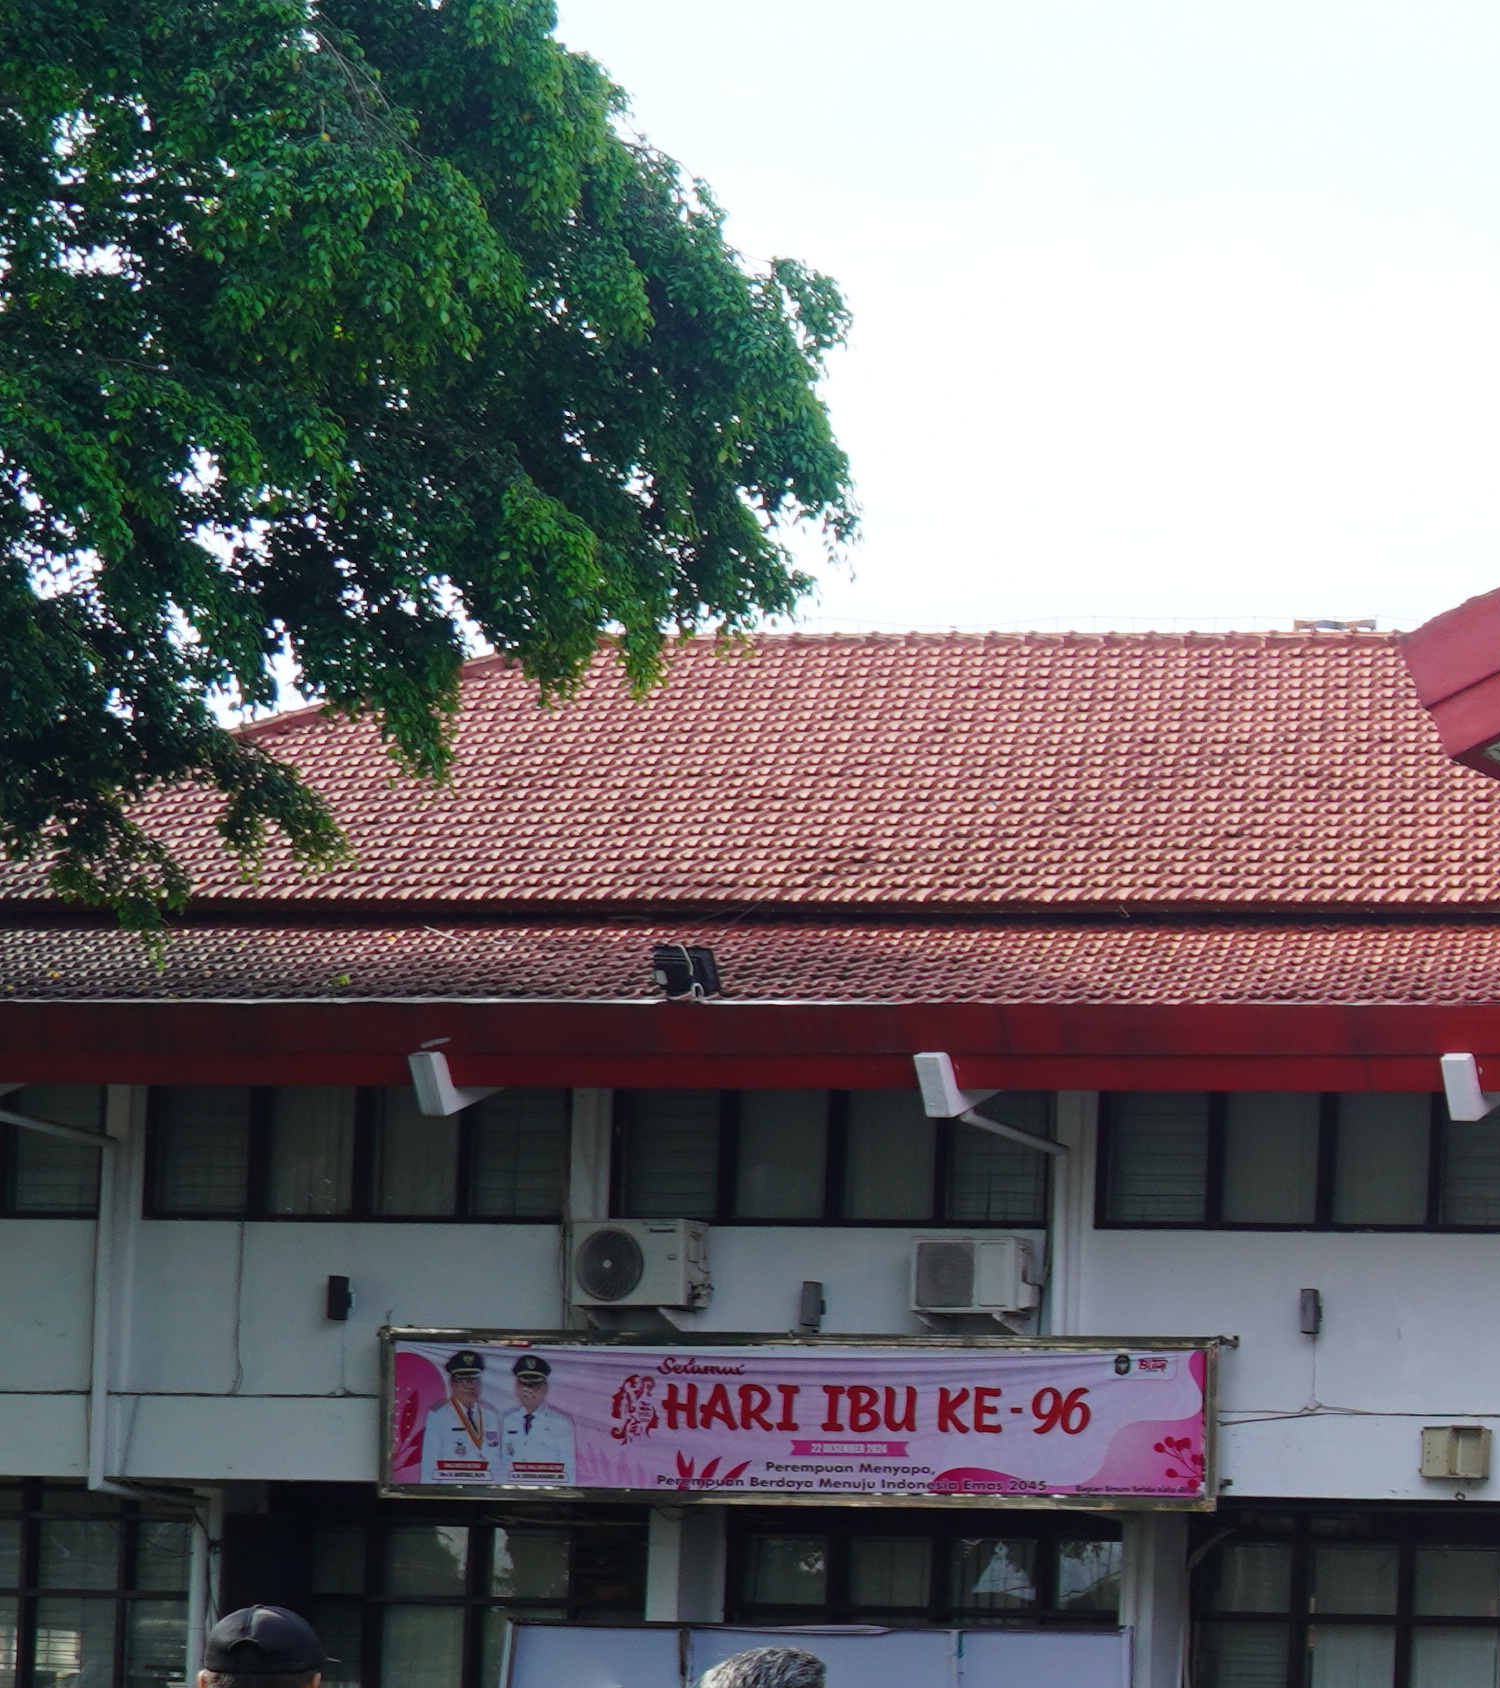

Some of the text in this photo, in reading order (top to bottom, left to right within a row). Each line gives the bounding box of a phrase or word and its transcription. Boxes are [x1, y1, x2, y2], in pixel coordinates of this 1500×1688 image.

[661, 1382, 800, 1431] HARI
[820, 1384, 918, 1433] IBU
[811, 1443, 821, 1454] 22
[866, 1445, 888, 1455] 2024
[766, 1462, 935, 1478] Perempuan Menyapa,
[657, 1475, 1047, 1492] Perempuan Berdaya Menuju Indonesia Emas 2045
